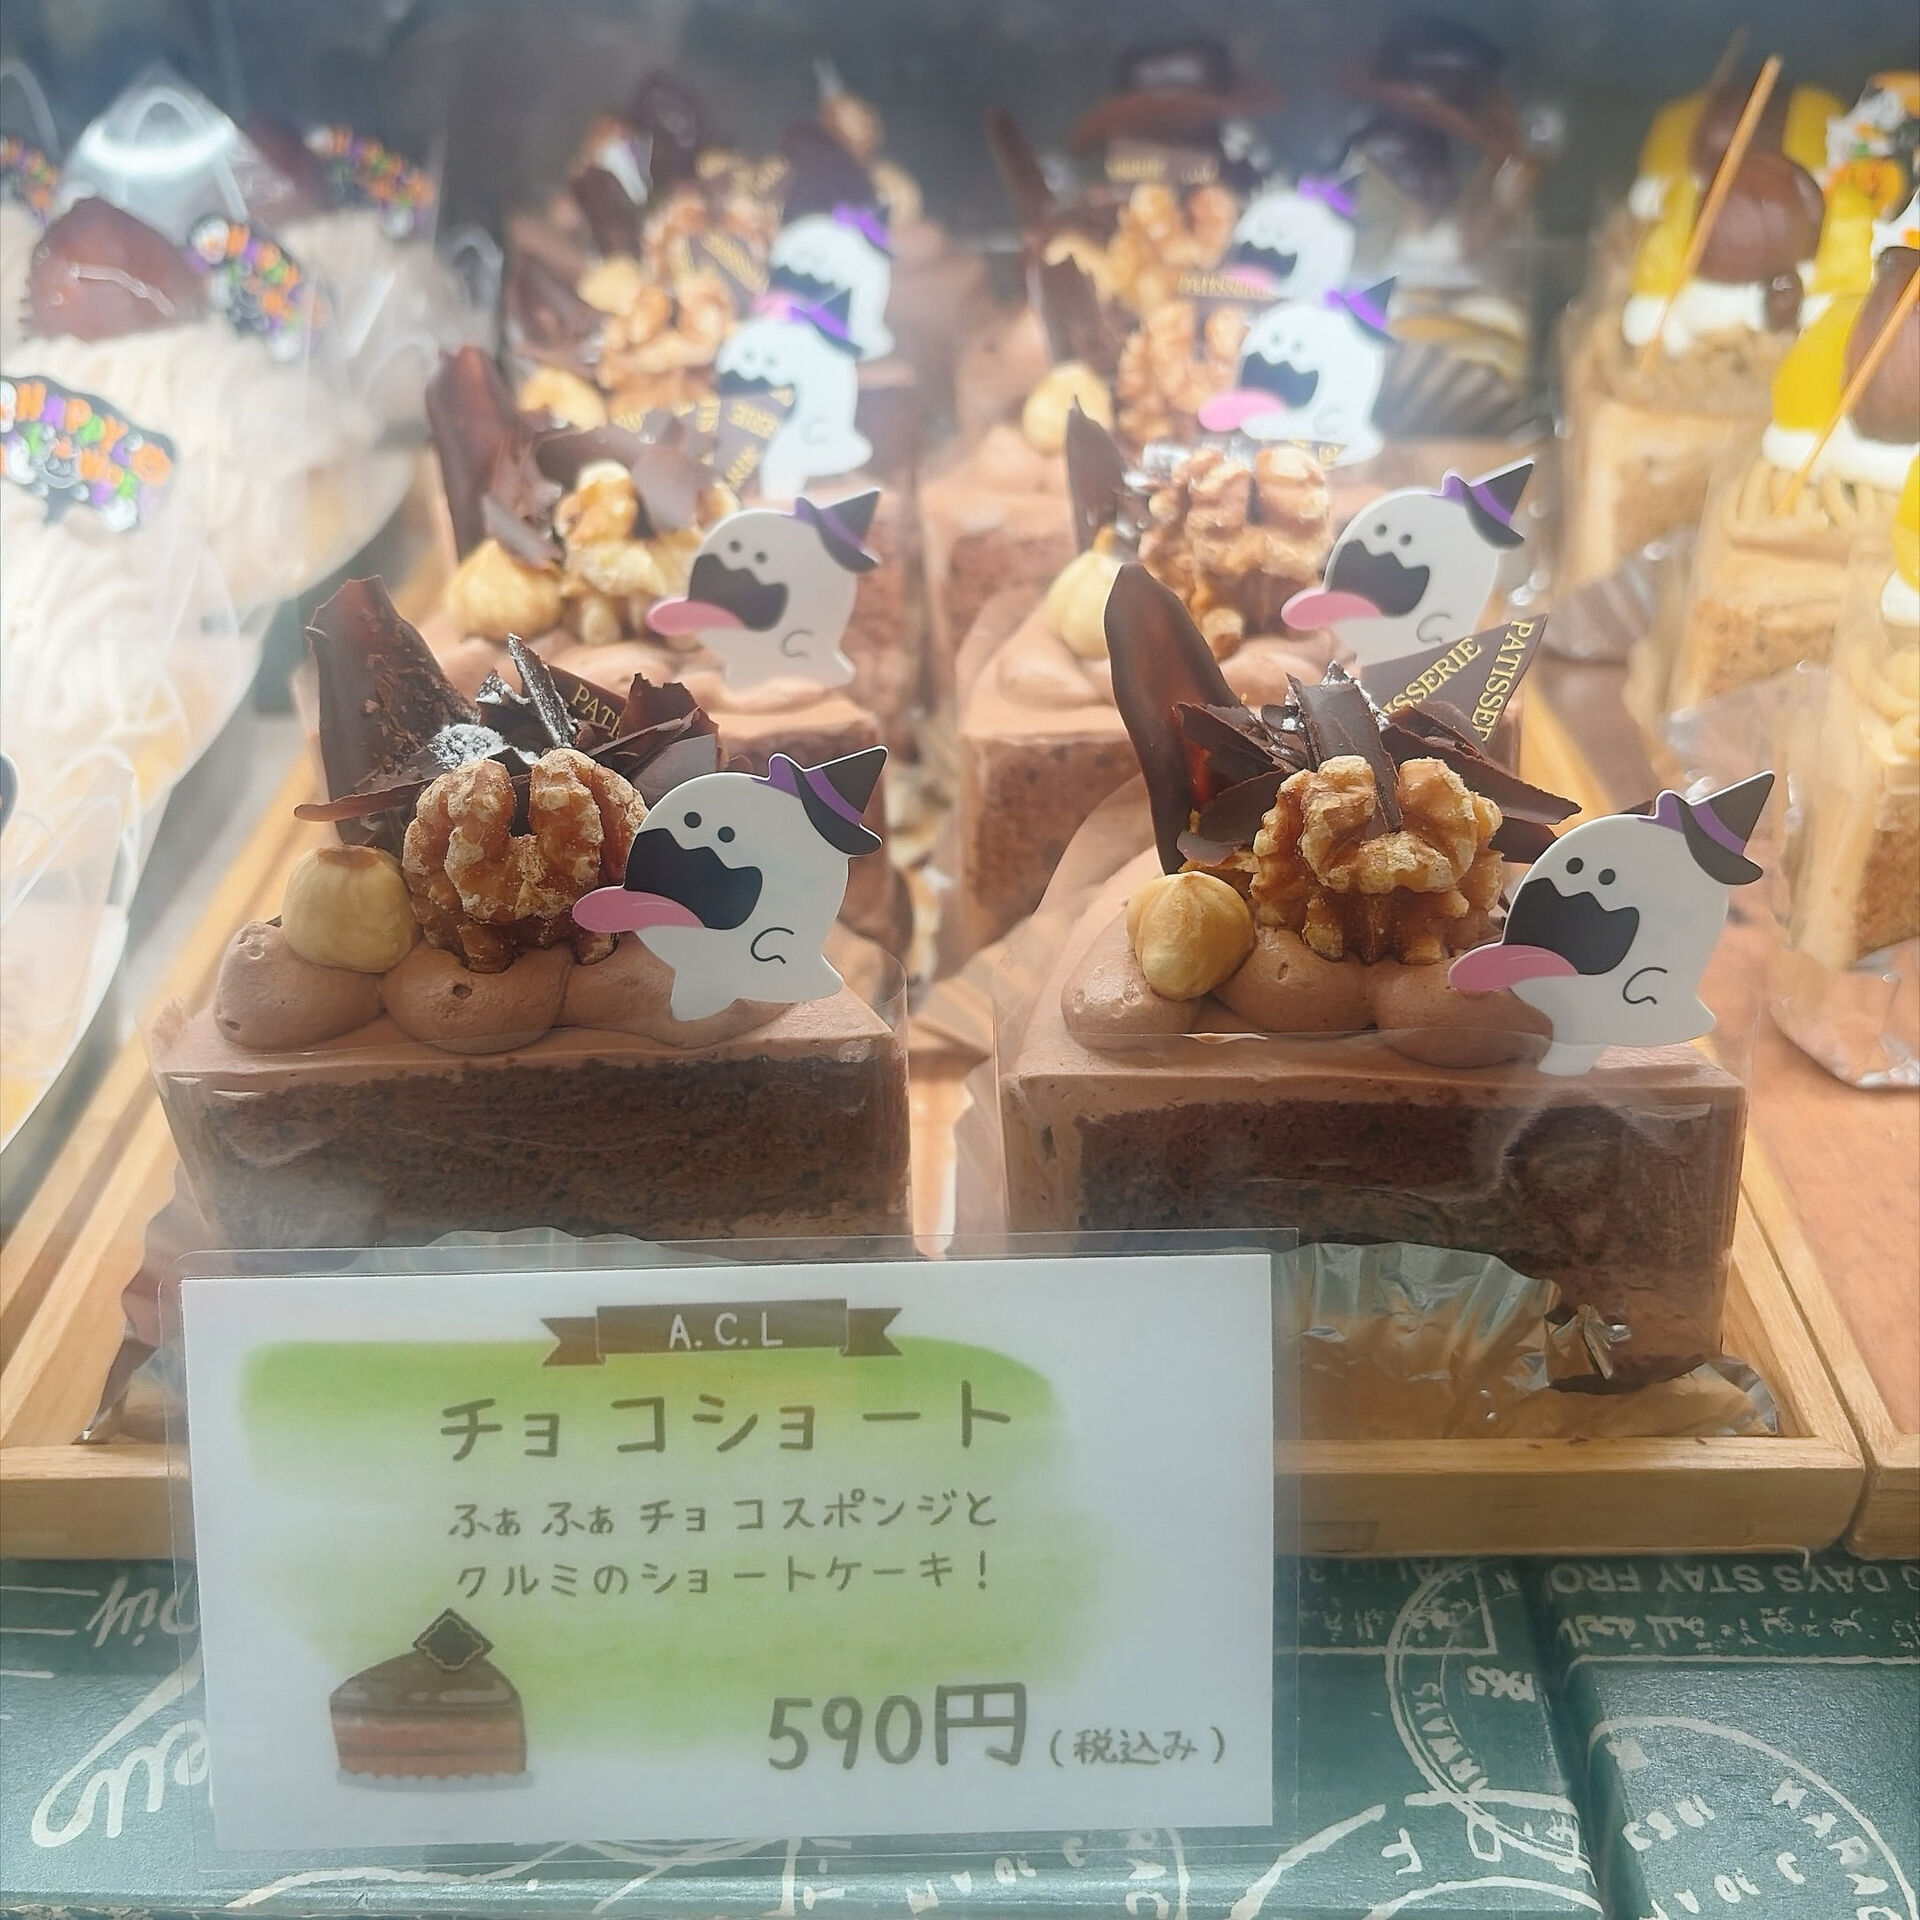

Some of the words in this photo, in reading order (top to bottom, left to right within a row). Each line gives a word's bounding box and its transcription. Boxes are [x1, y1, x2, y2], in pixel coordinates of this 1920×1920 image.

[668, 1311, 783, 1349] A.C.L
[440, 1380, 1011, 1461] チョコショート
[1656, 1565, 1765, 1594] STAY
[1771, 1565, 1890, 1594] DAYS
[767, 1681, 1027, 1770] 590円
